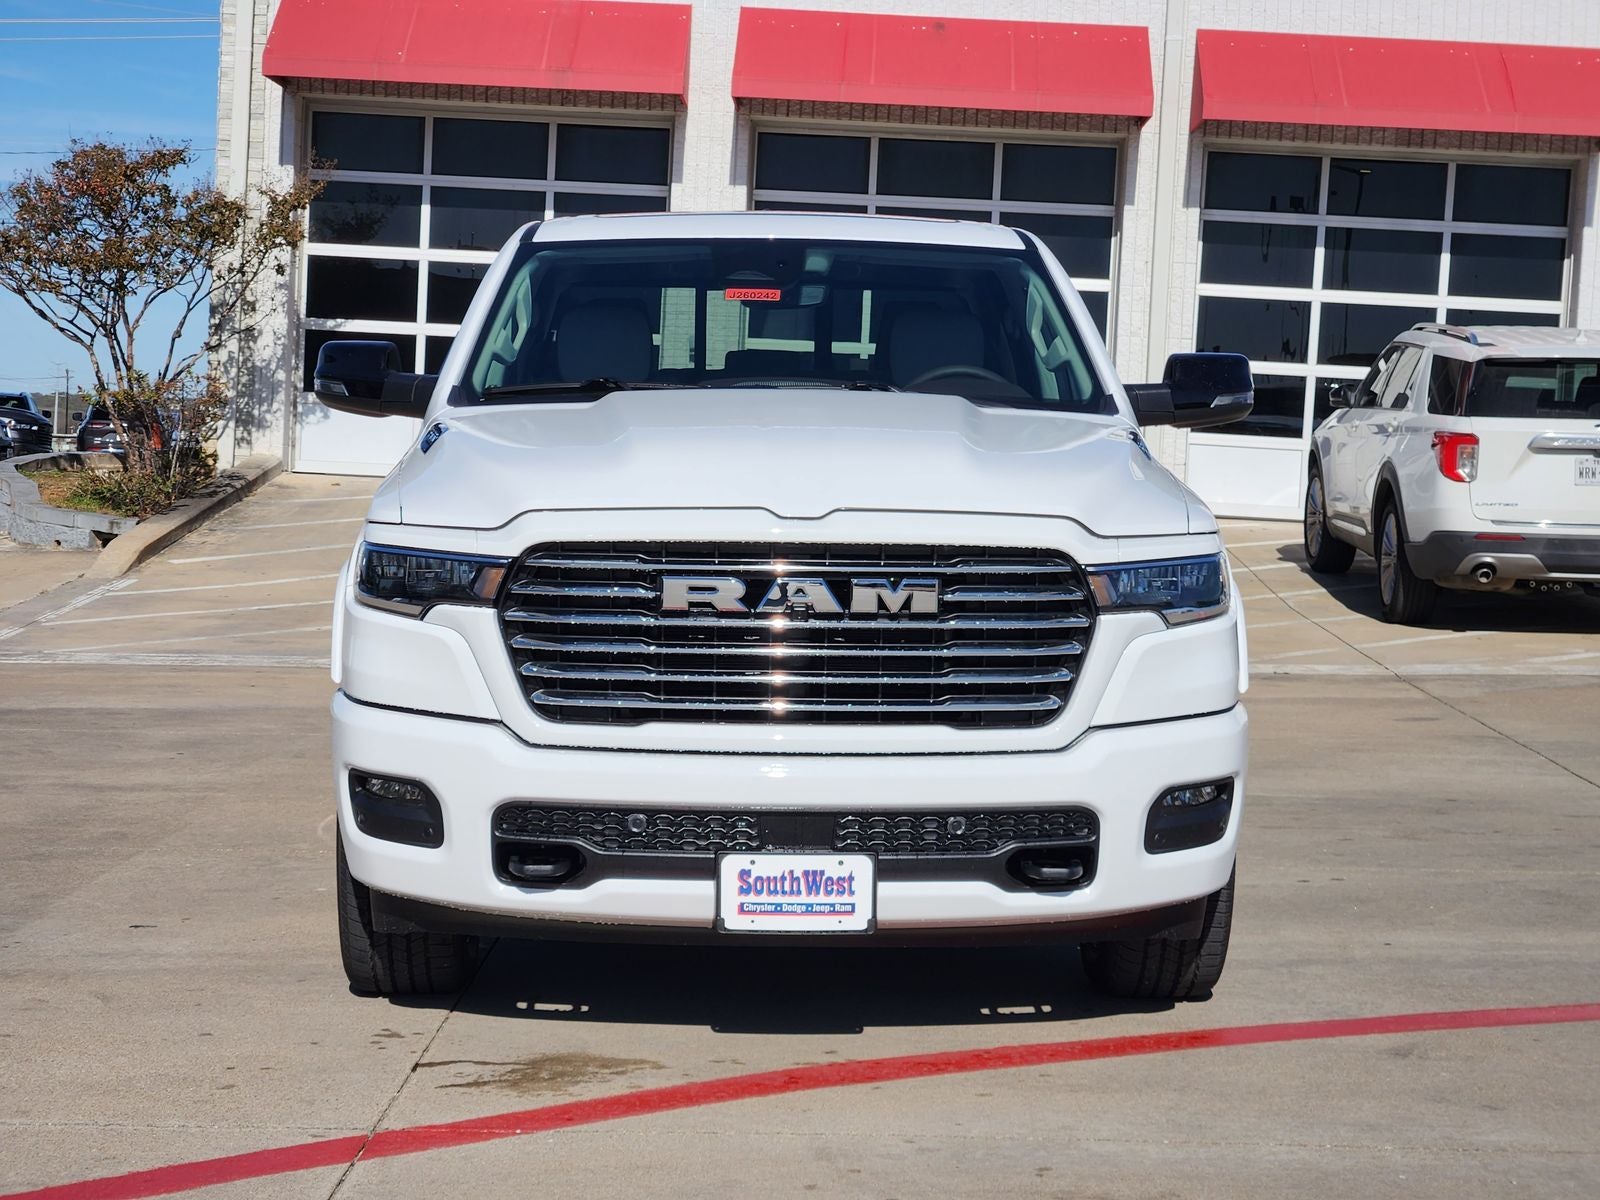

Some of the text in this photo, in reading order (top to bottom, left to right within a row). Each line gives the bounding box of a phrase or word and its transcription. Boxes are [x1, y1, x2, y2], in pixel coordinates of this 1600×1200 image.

[729, 291, 777, 299] J260242
[660, 575, 939, 613] RAM
[737, 868, 855, 897] SouthWest
[743, 903, 852, 913] Chrysler Dodge Jeep Ram
